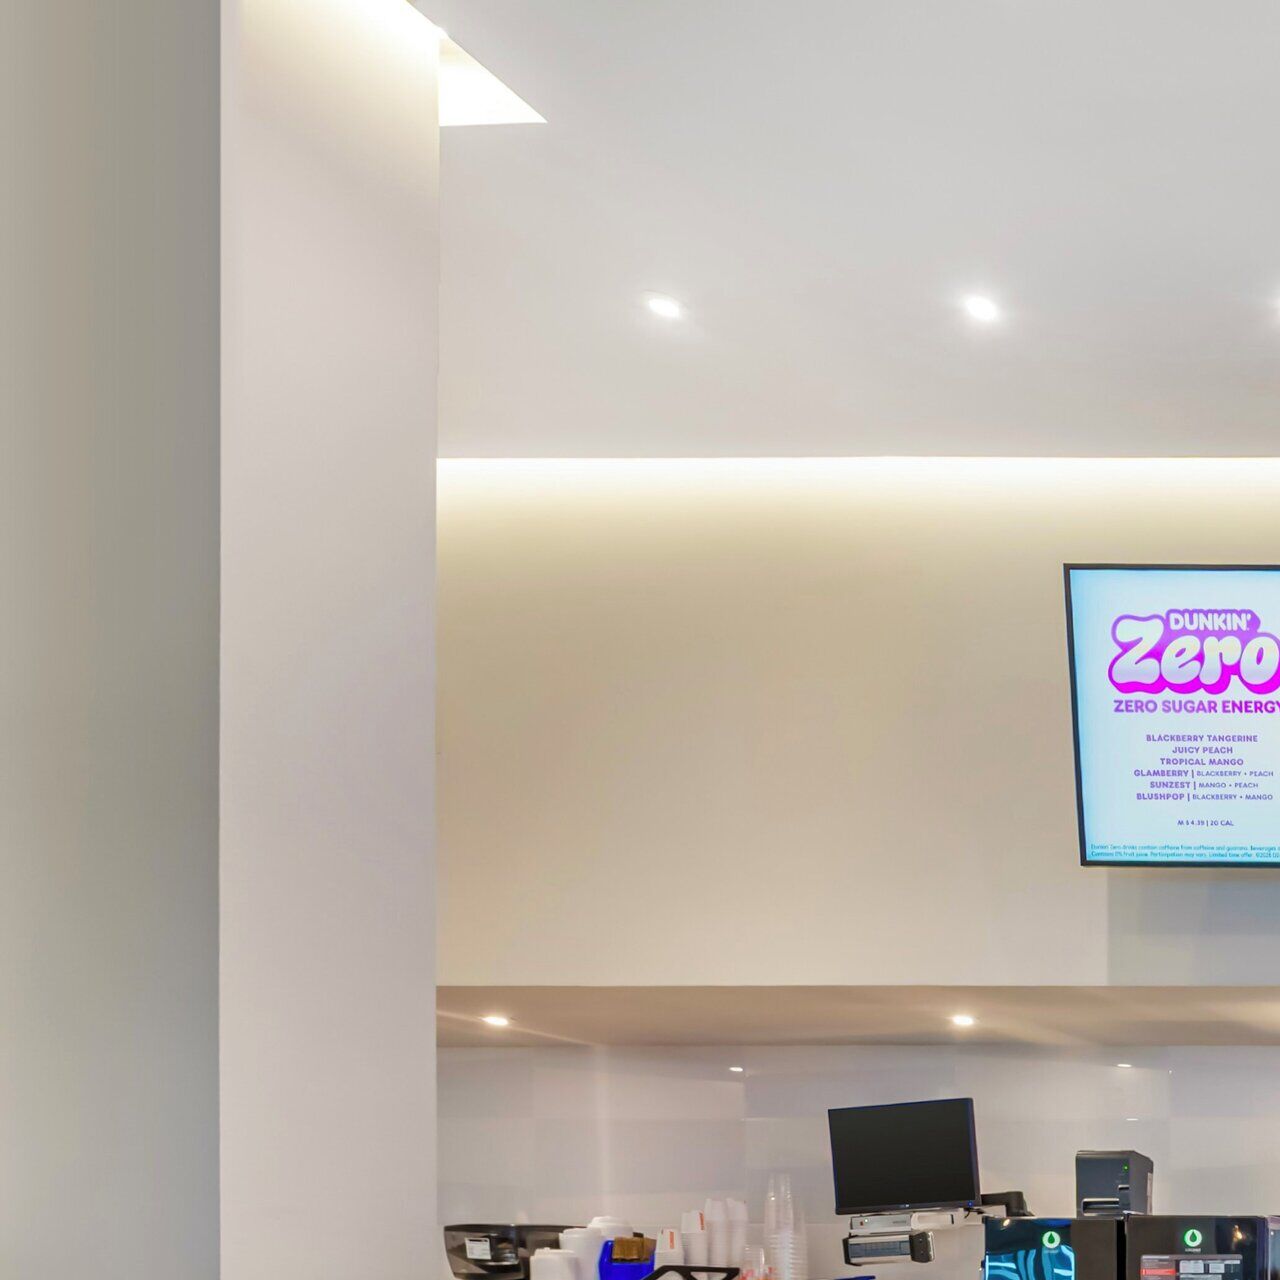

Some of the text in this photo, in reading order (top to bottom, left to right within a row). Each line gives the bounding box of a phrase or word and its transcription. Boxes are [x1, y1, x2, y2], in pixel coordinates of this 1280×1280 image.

[1168, 611, 1252, 631] DUNKIN'
[1113, 699, 1158, 713] ZERO
[1162, 699, 1218, 713] SUGAR
[1146, 734, 1258, 743] BLACKBERRY TANGERINE
[1171, 746, 1233, 754] JUICY PEACH
[1159, 757, 1244, 766] TROPICAL MANGO
[1133, 768, 1189, 778] GLAMBERRY
[1149, 780, 1191, 789] SUNZEST
[1136, 792, 1274, 801] BLUSHPOP BLACKBERRY MANGO
